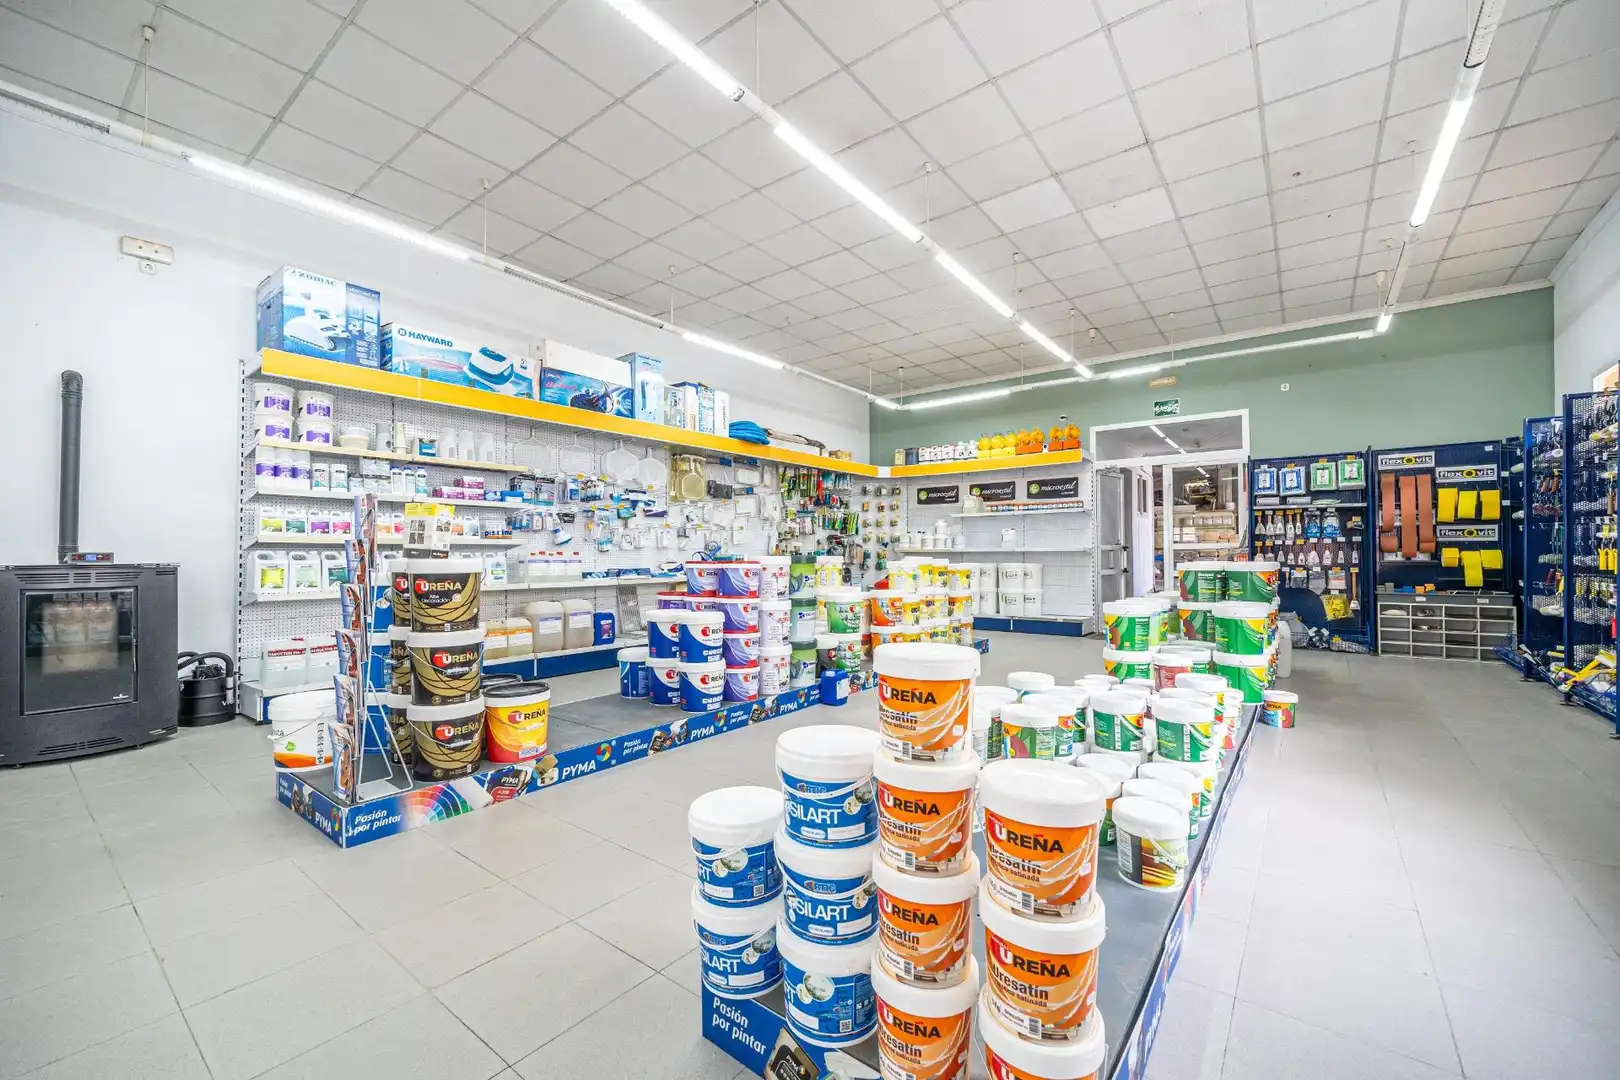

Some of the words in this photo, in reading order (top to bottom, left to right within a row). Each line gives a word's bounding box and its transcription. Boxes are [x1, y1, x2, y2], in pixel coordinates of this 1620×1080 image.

[299, 270, 338, 287] ZODIAC
[408, 331, 453, 347] HAYWARD
[420, 580, 462, 593] UREÑA
[442, 651, 478, 664] UREÑA
[883, 682, 937, 704] UREÑA
[516, 709, 546, 721] UREÑA
[780, 702, 798, 714] PYMA
[444, 721, 479, 737] UREÑA
[691, 725, 715, 740] PYMA
[623, 747, 632, 756] por
[562, 760, 597, 780] PYMA
[501, 777, 519, 785] PYMA
[790, 801, 842, 825] SILART
[884, 791, 941, 816] UREÑA
[315, 812, 333, 835] PYMA
[354, 822, 370, 836] por
[373, 814, 402, 831] pintar
[355, 810, 387, 825] Pasión
[995, 823, 1064, 854] UREÑA
[1010, 868, 1040, 882] satinada
[795, 898, 851, 921] SILART
[883, 898, 939, 926] UREÑA
[1000, 949, 1071, 978] UREÑA
[993, 964, 1049, 1000] Uresatín
[1016, 992, 1048, 1008] satinada
[713, 996, 748, 1028] Pasión
[883, 1009, 942, 1038] UREÑA
[712, 1014, 729, 1032] por
[732, 1026, 767, 1055] pintar
[786, 1054, 799, 1072] PYMA
